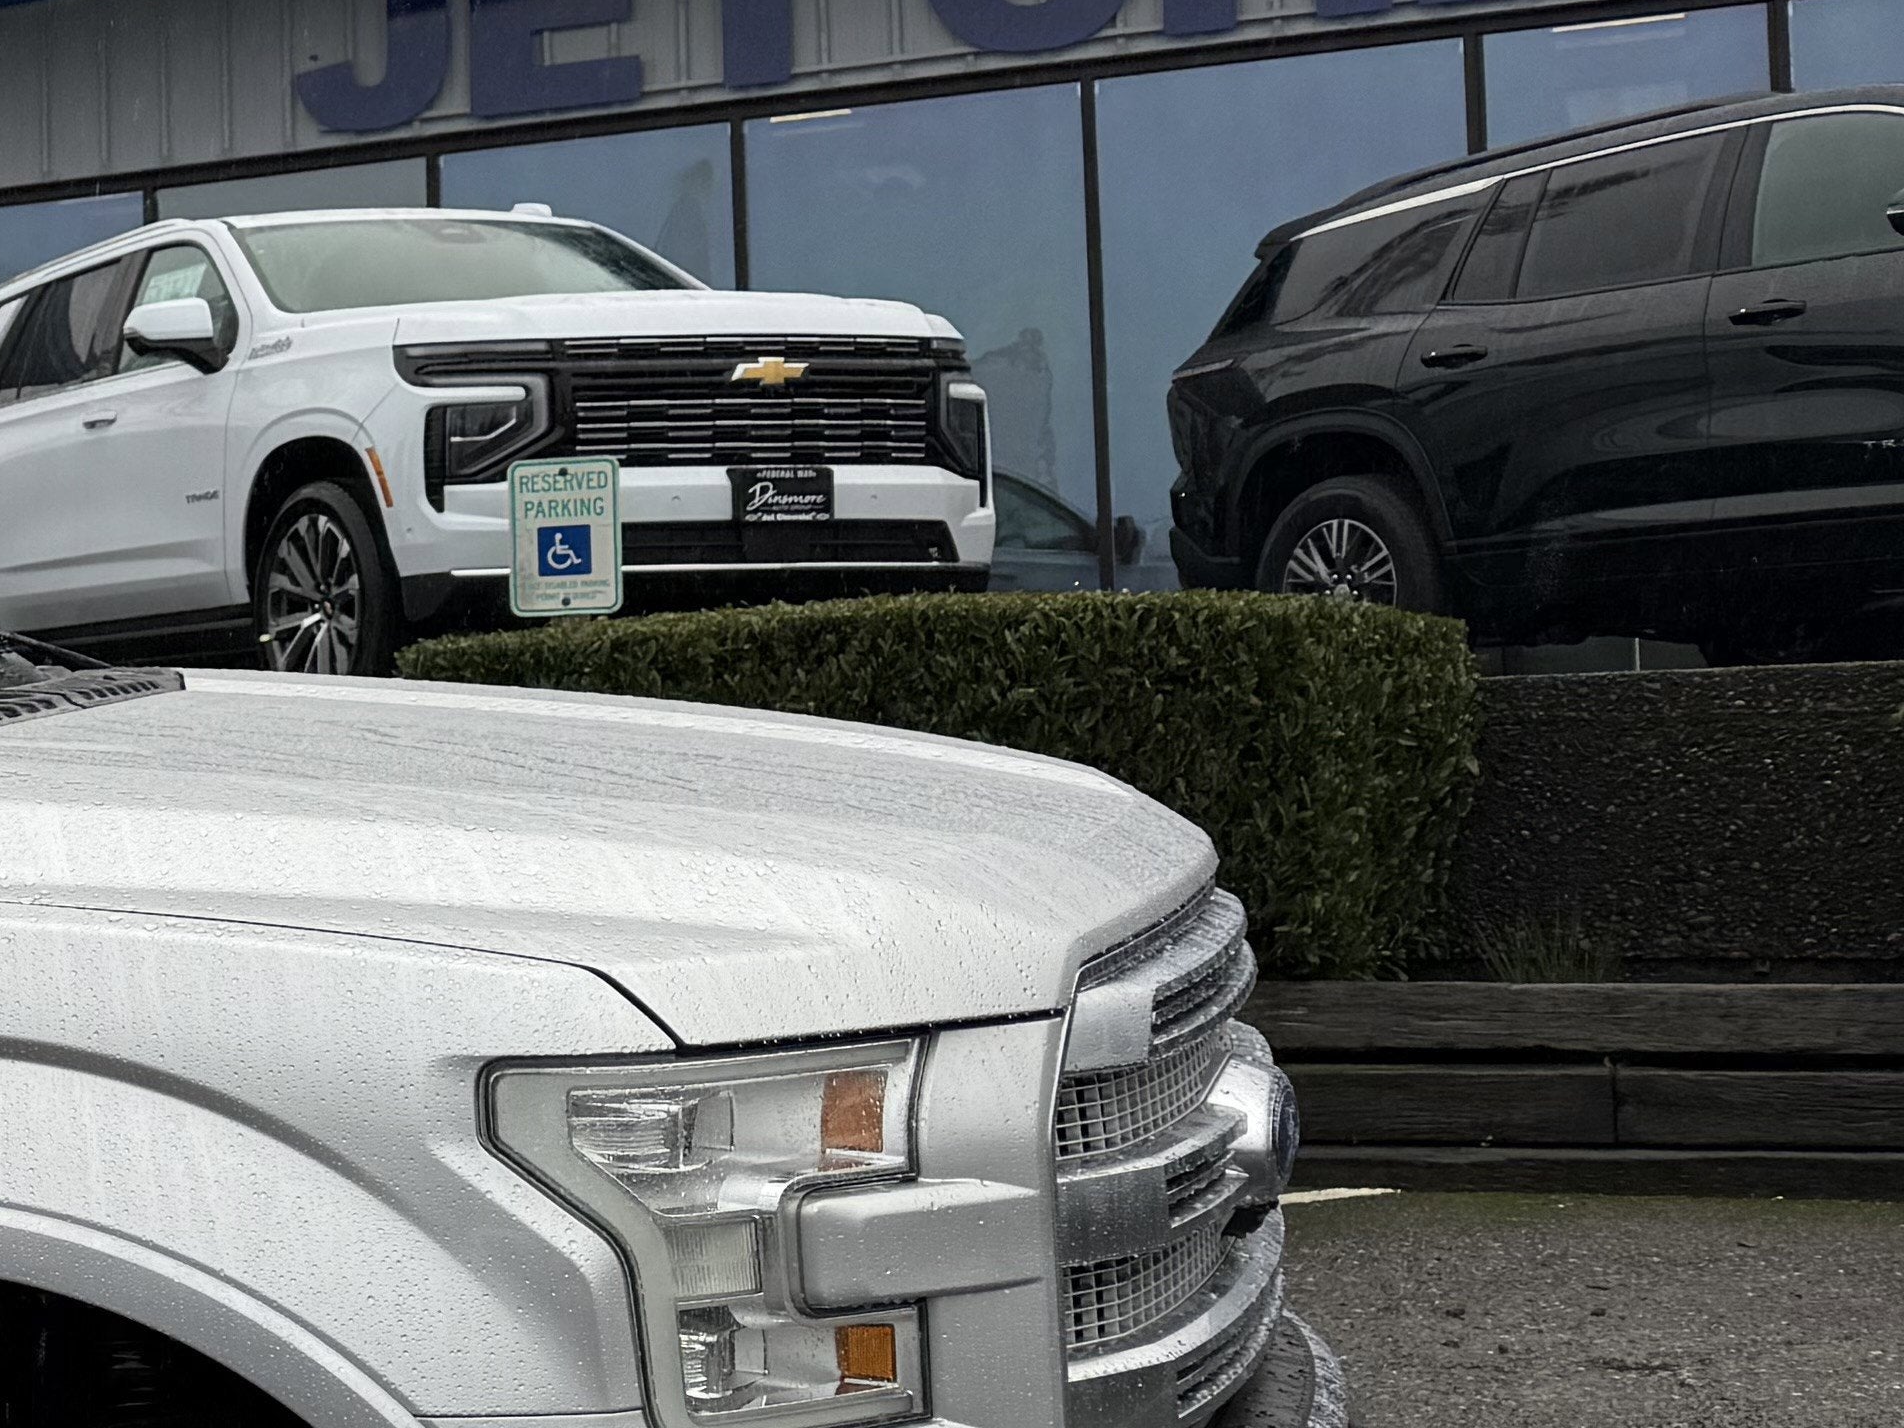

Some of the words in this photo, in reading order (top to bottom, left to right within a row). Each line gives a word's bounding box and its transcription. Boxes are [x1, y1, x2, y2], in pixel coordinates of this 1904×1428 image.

[519, 471, 608, 494] RESERVED
[746, 481, 827, 510] Dinsmore
[524, 497, 605, 520] PARKING
